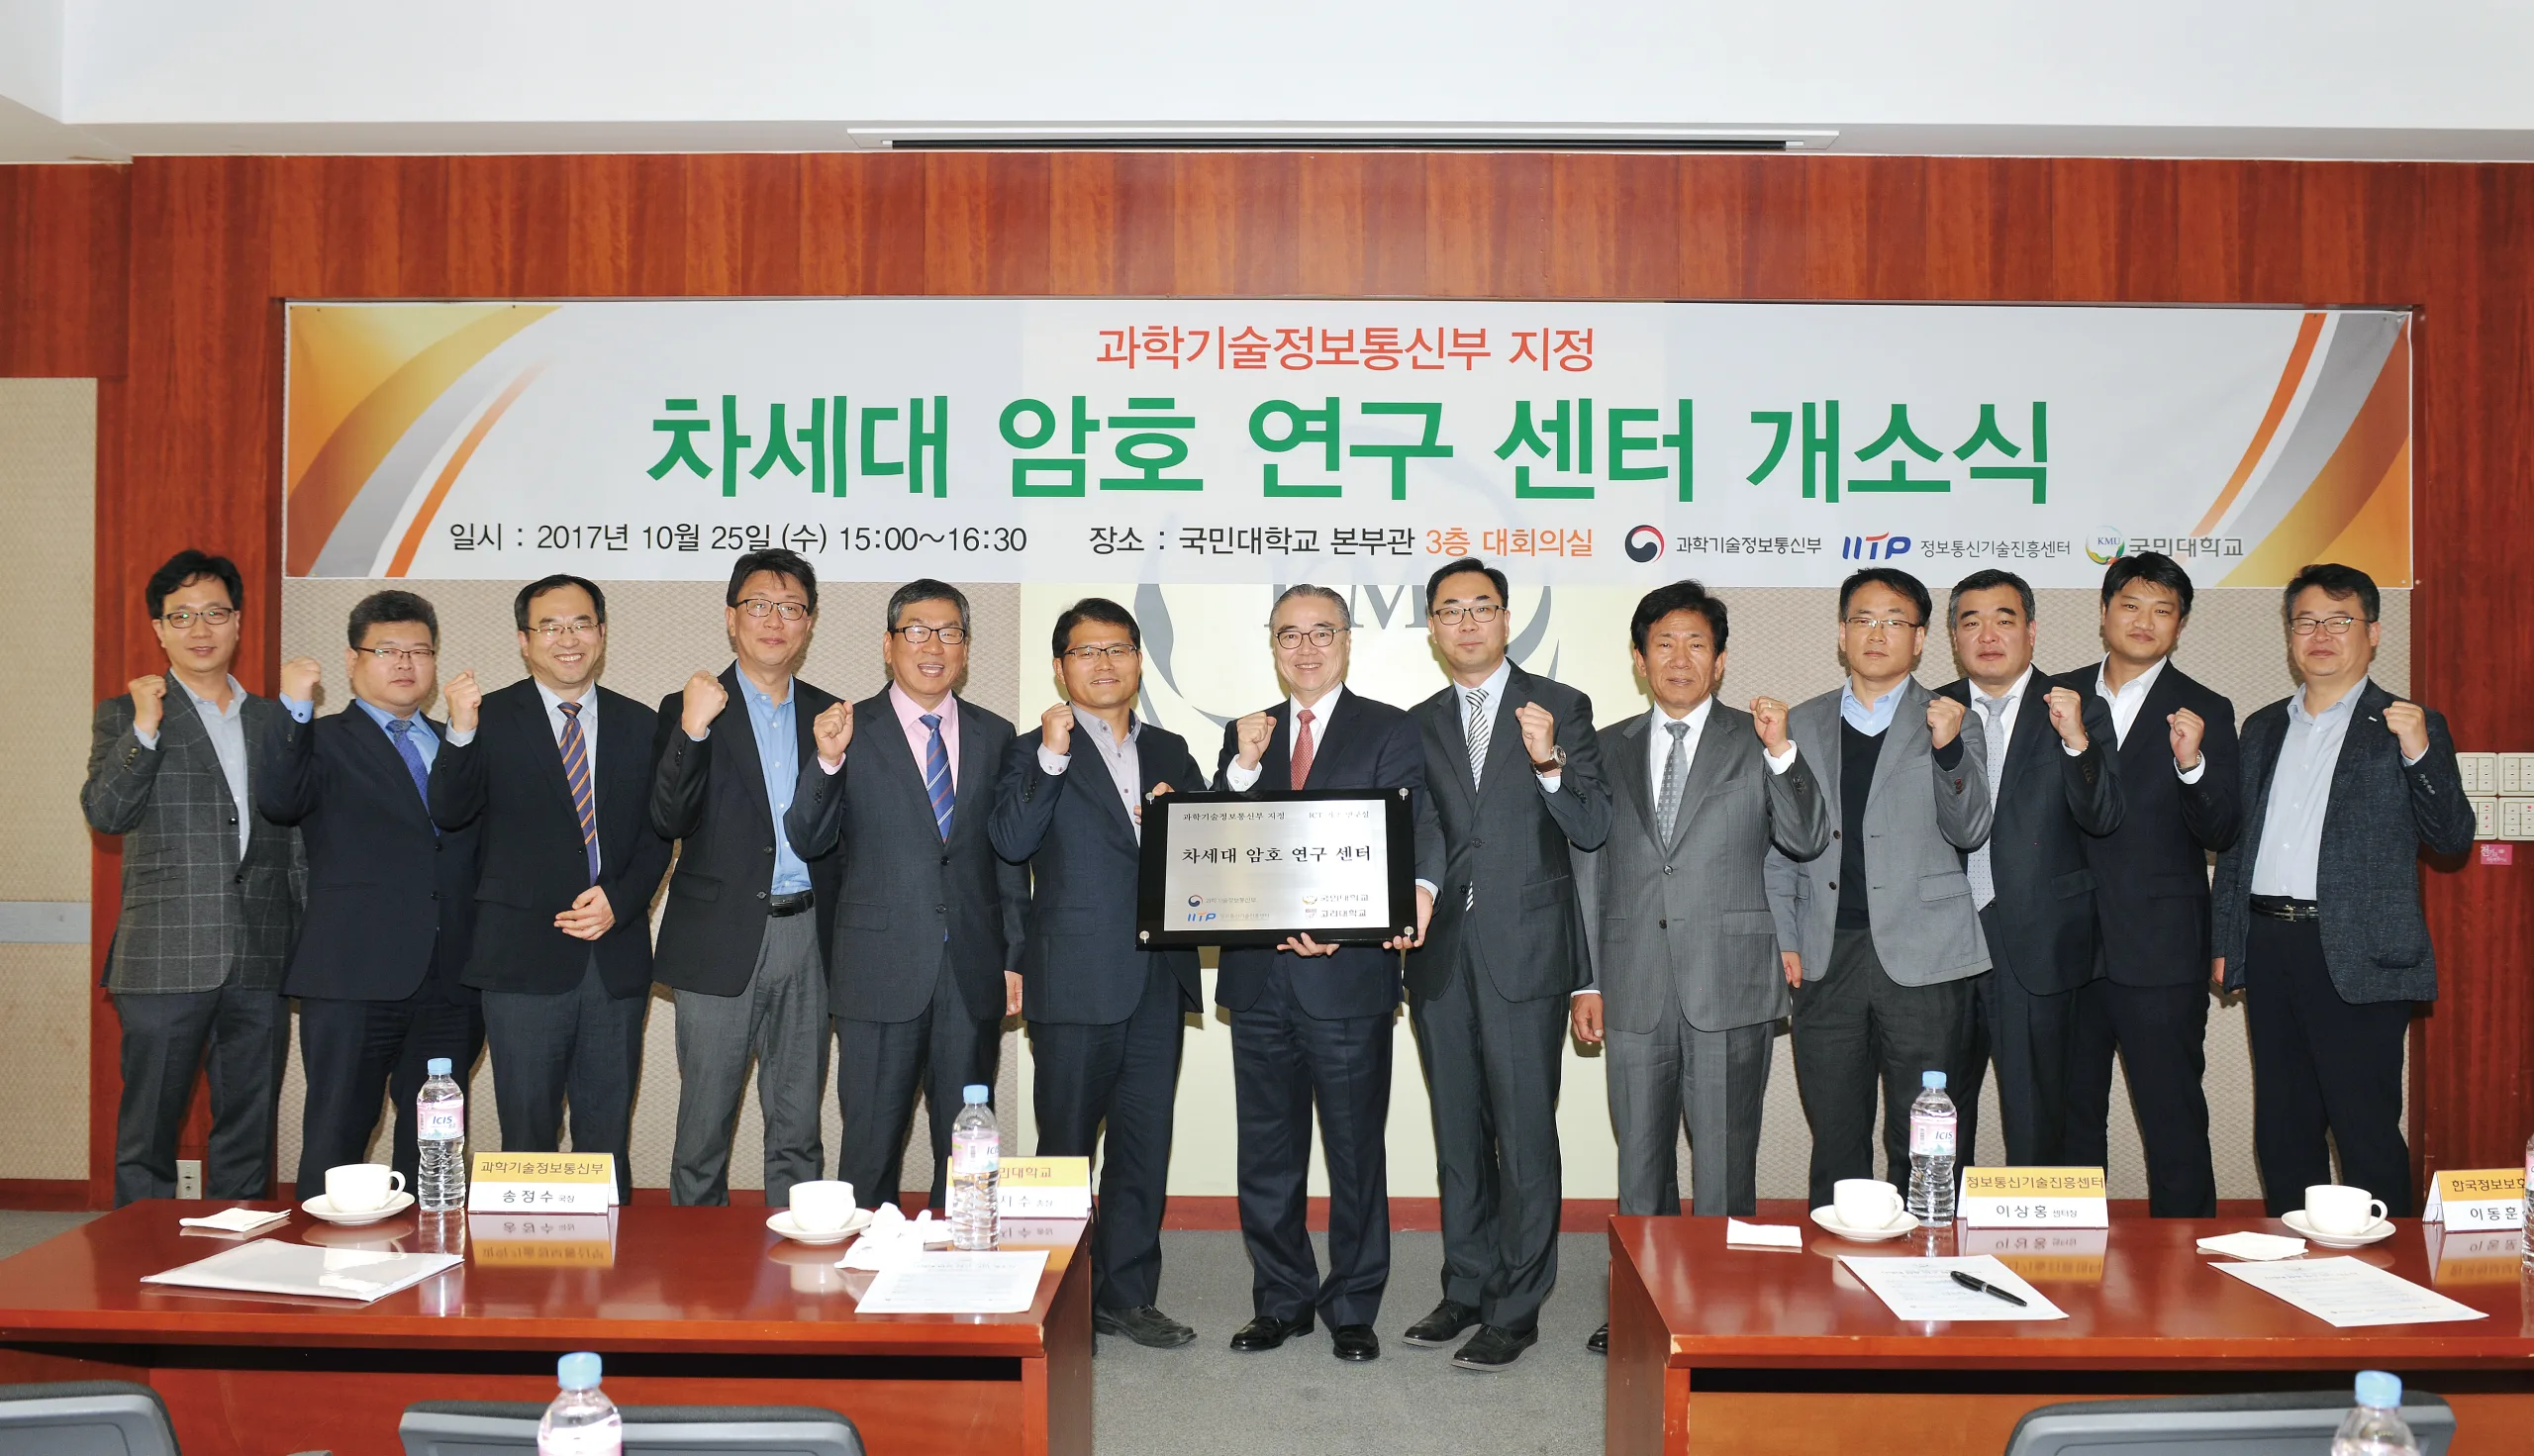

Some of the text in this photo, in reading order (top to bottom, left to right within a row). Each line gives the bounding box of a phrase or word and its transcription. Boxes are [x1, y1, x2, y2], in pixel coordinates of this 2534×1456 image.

[1097, 326, 1593, 371] 과학기술정보통신부 지정
[646, 395, 2047, 504] 차세대 암호 연구 센터 개소식
[450, 524, 501, 550] 일시
[537, 524, 628, 550] 2017년
[643, 524, 699, 551] 10월
[708, 521, 772, 552] 25일
[779, 520, 828, 556] (수)
[1090, 527, 1144, 554] 장소
[1179, 527, 1319, 555] 국민대학교
[1330, 528, 1415, 555] 본부관
[1425, 527, 1471, 557] 3층
[1484, 529, 1592, 556] 대회의실
[1677, 536, 1821, 554] 과학기술정보통신부
[1842, 533, 1910, 559] IITP
[2095, 535, 2122, 547] KMU
[2129, 536, 2244, 558] 국민대학교
[1921, 540, 2070, 558] 정보통신기술진흥센터
[1182, 846, 1369, 864] 차세대 암호 연구 센터
[1188, 912, 1217, 922] IITP
[433, 1116, 452, 1124] ICIS
[1935, 1130, 1953, 1140] ICIS
[481, 1162, 603, 1174] 과학기술정보통신부
[999, 1166, 1052, 1179] 민대학교
[1966, 1176, 2104, 1190] 정보통신기술진흥센터
